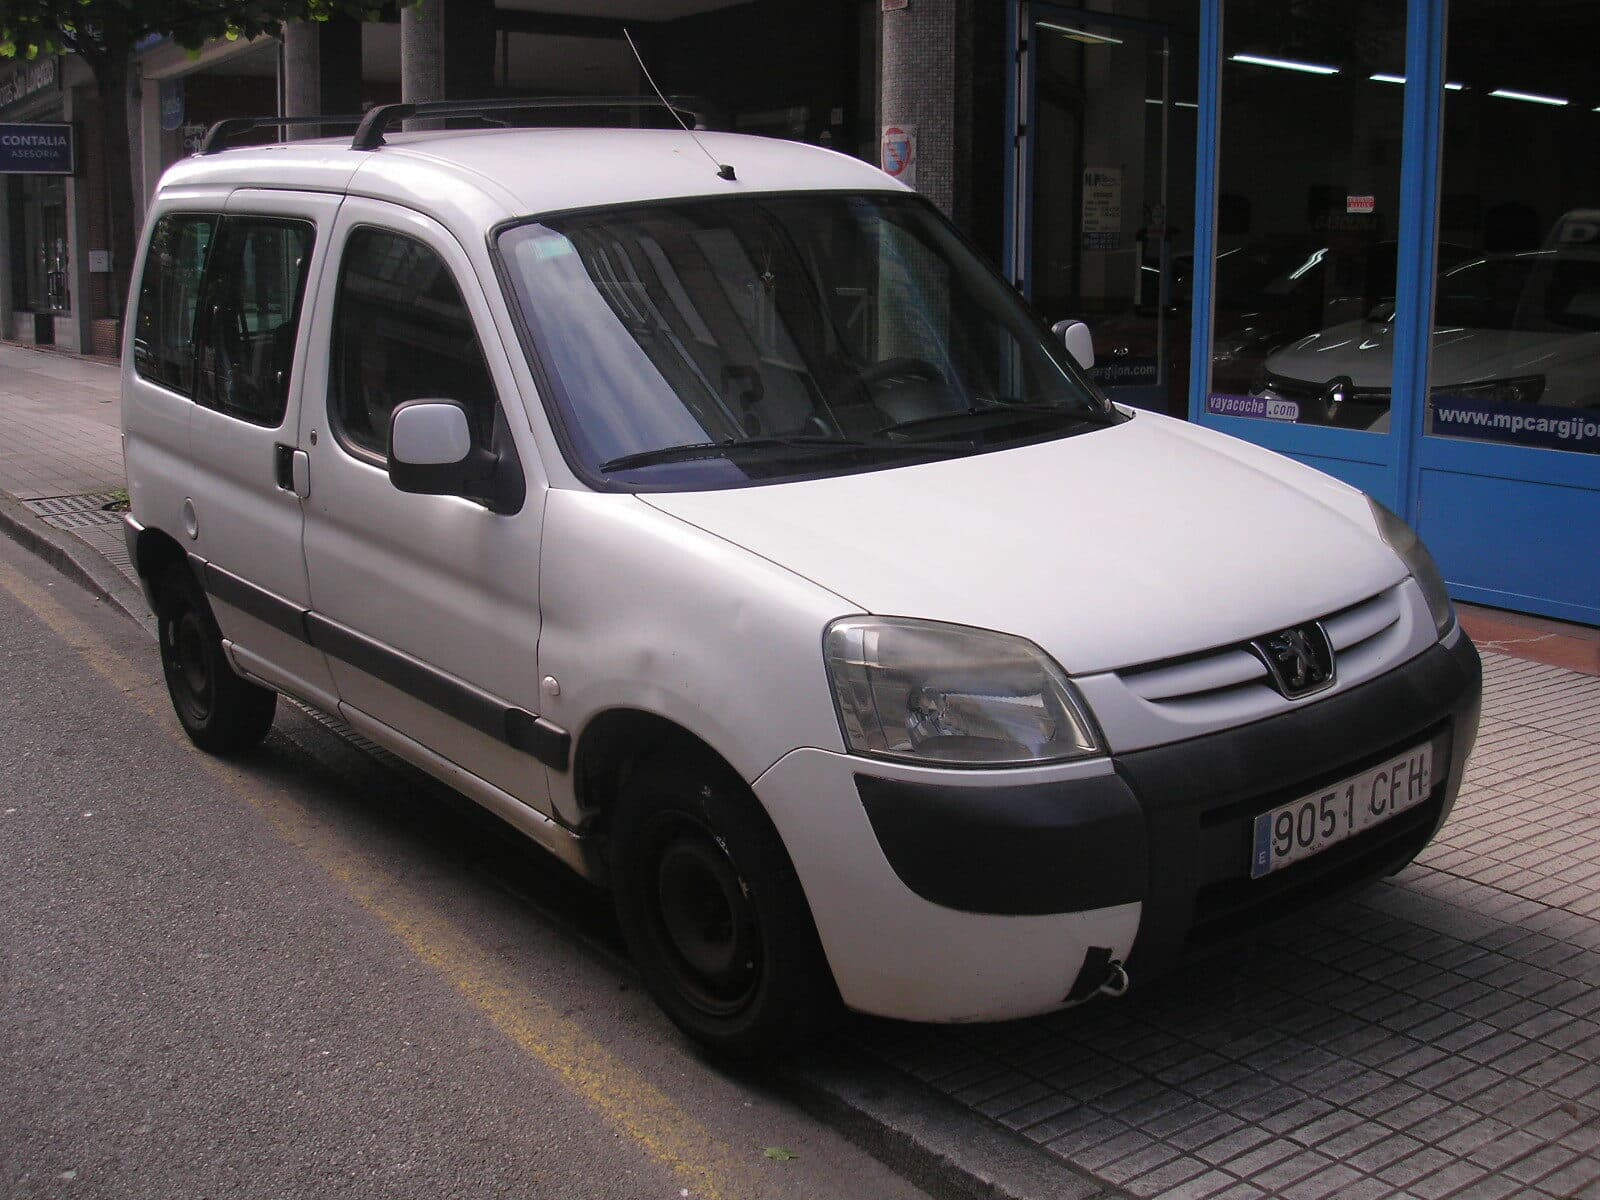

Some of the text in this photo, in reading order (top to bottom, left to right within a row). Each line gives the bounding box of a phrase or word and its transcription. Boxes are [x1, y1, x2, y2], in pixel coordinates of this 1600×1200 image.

[2, 135, 67, 146] CONTALIA
[1274, 754, 1424, 857] 9051 CFH
[1258, 850, 1267, 865] E
